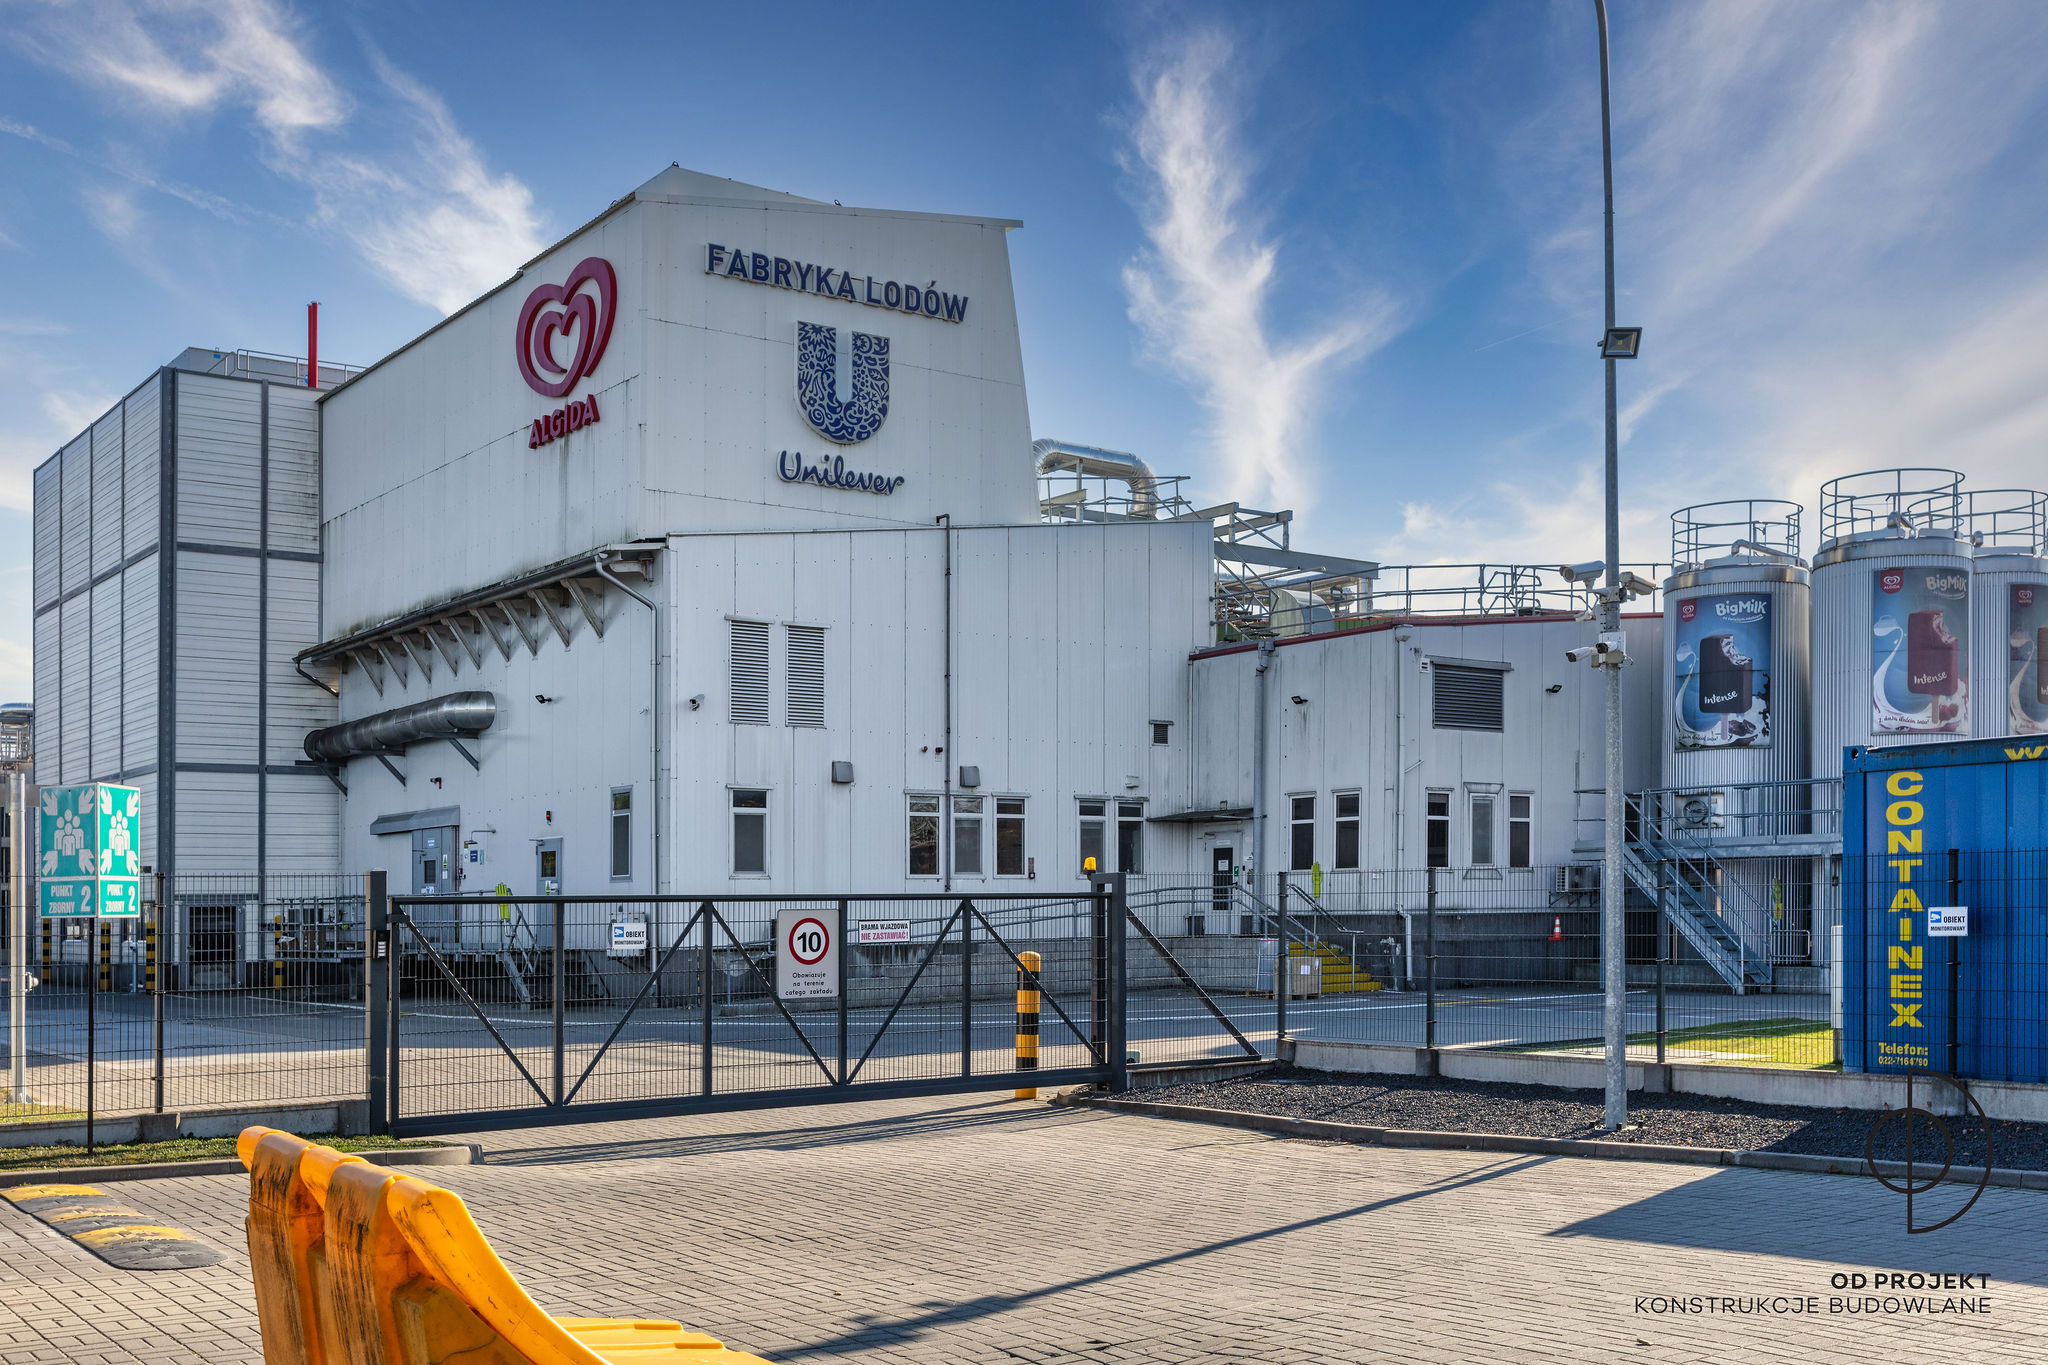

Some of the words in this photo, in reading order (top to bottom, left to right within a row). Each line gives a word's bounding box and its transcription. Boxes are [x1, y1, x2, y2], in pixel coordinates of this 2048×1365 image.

[705, 242, 856, 301] FABRYKA
[865, 280, 969, 323] LODÓW
[529, 394, 600, 449] ALGIDA
[777, 450, 905, 495] Unilever
[1715, 599, 1767, 616] BigMilk
[1914, 671, 1947, 685] Intense
[1704, 690, 1738, 704] Intense
[51, 885, 73, 896] PUNKT
[107, 884, 122, 896] PUNKT
[80, 885, 91, 912] 2
[128, 885, 136, 911] 2
[1886, 771, 1925, 1028] CONTAINEX
[48, 902, 75, 914] ZBORNY
[797, 932, 821, 952] 10
[861, 932, 871, 940] NIE
[872, 931, 909, 940] ZASTAWIAĆ!
[1878, 1042, 1928, 1055] Telefon:
[1878, 1056, 1928, 1066] 022-7164790
